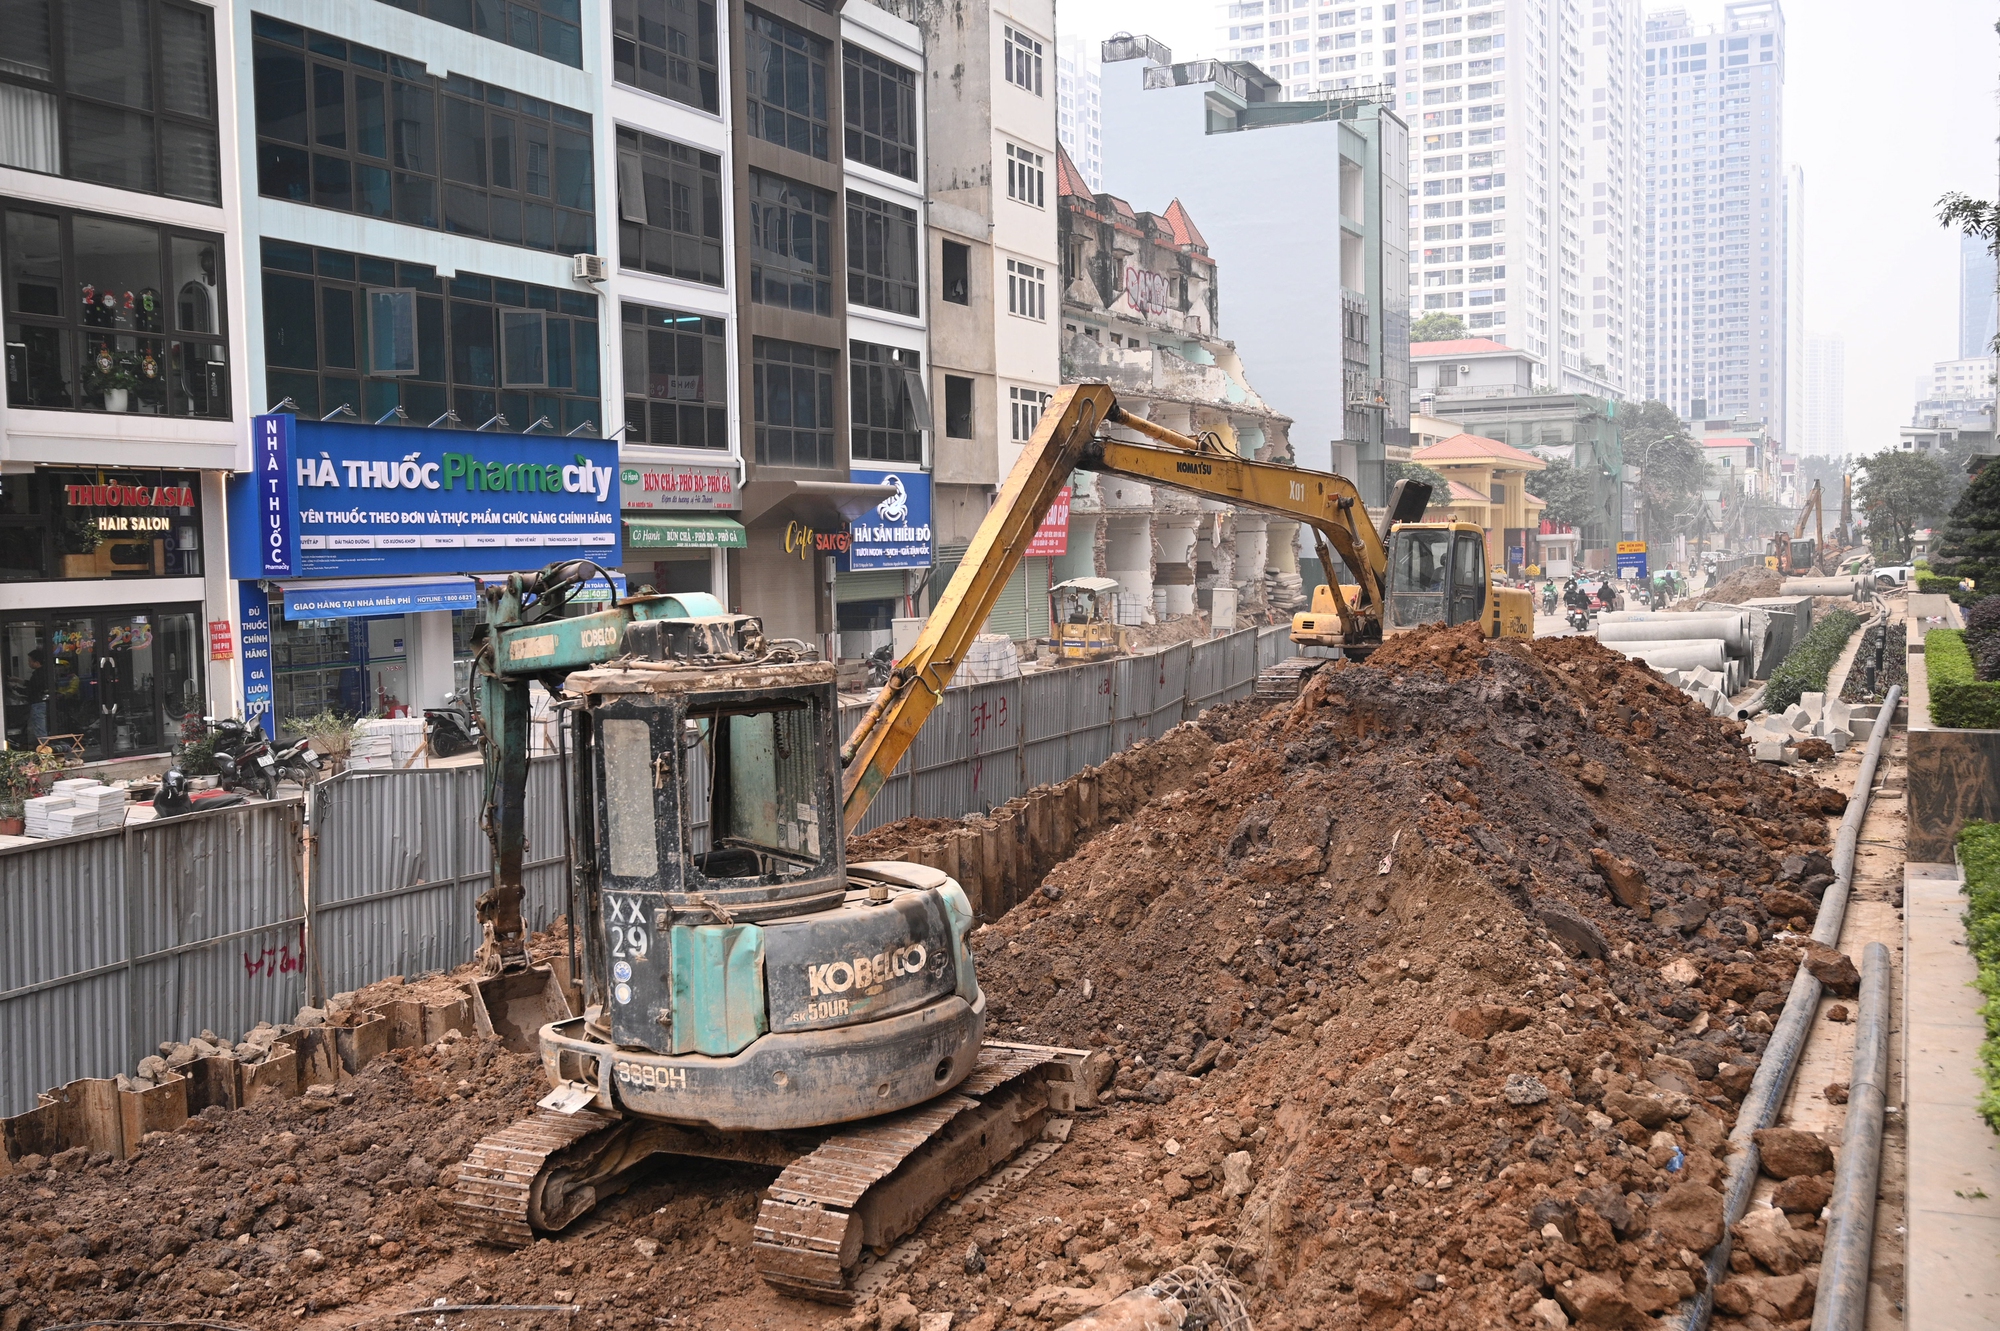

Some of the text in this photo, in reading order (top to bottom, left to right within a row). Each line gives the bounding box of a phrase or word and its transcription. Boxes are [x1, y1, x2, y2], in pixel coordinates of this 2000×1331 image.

[266, 420, 278, 471] NHÀ
[297, 451, 613, 503] HÀ THUỐC Pharmacity
[621, 472, 628, 481] Cô
[1176, 461, 1212, 475] KOMATSU
[642, 468, 659, 492] BÚN
[660, 467, 676, 492] CHẢ
[678, 467, 693, 492] PHỞ
[693, 470, 703, 492] BÒ
[706, 468, 721, 493] PHỞ
[721, 471, 731, 493] GÀ
[65, 479, 195, 507] THƯỞNG ASIA
[1289, 480, 1305, 502] X01
[98, 517, 170, 531] HAIR SALON
[268, 479, 283, 564] THUỐC
[300, 506, 612, 527] YÊN THUỐC THEO ĐƠN VÀ THỰC PHẨM CHỨC NĂNG CHÍNH HÃNG
[632, 529, 641, 541] Cô
[643, 529, 661, 543] Hạnh
[667, 528, 679, 542] BÚN
[679, 528, 691, 542] CHẢ
[694, 528, 706, 542] PHỞ
[706, 529, 715, 542] BÒ
[717, 528, 729, 542] PHỞ
[730, 530, 738, 542] GÀ
[785, 520, 813, 561] Cafe
[854, 520, 931, 542] HẢI SẢN HIẾU ĐÔ
[856, 547, 869, 557] TƯƠI
[869, 547, 883, 556] NGON
[885, 547, 898, 558] SẠCH
[920, 543, 930, 555] GỐC
[265, 562, 290, 571] Pharmacity
[248, 605, 260, 616] ĐỦ
[293, 595, 411, 611] GIAO HÀNG TẠI NHÀ MIỄN PHÍ
[242, 619, 267, 630] THUỐC
[243, 633, 268, 643] CHÍNH
[580, 626, 617, 648] KOBELCO
[245, 647, 268, 659] HÃNG
[250, 668, 265, 679] GIÁ
[247, 684, 268, 694] LUÔN
[246, 696, 271, 715] TỐT
[607, 895, 647, 924] XX
[611, 926, 648, 957] 29
[808, 943, 927, 997] KOBELCO
[792, 998, 849, 1022] SK 50UR
